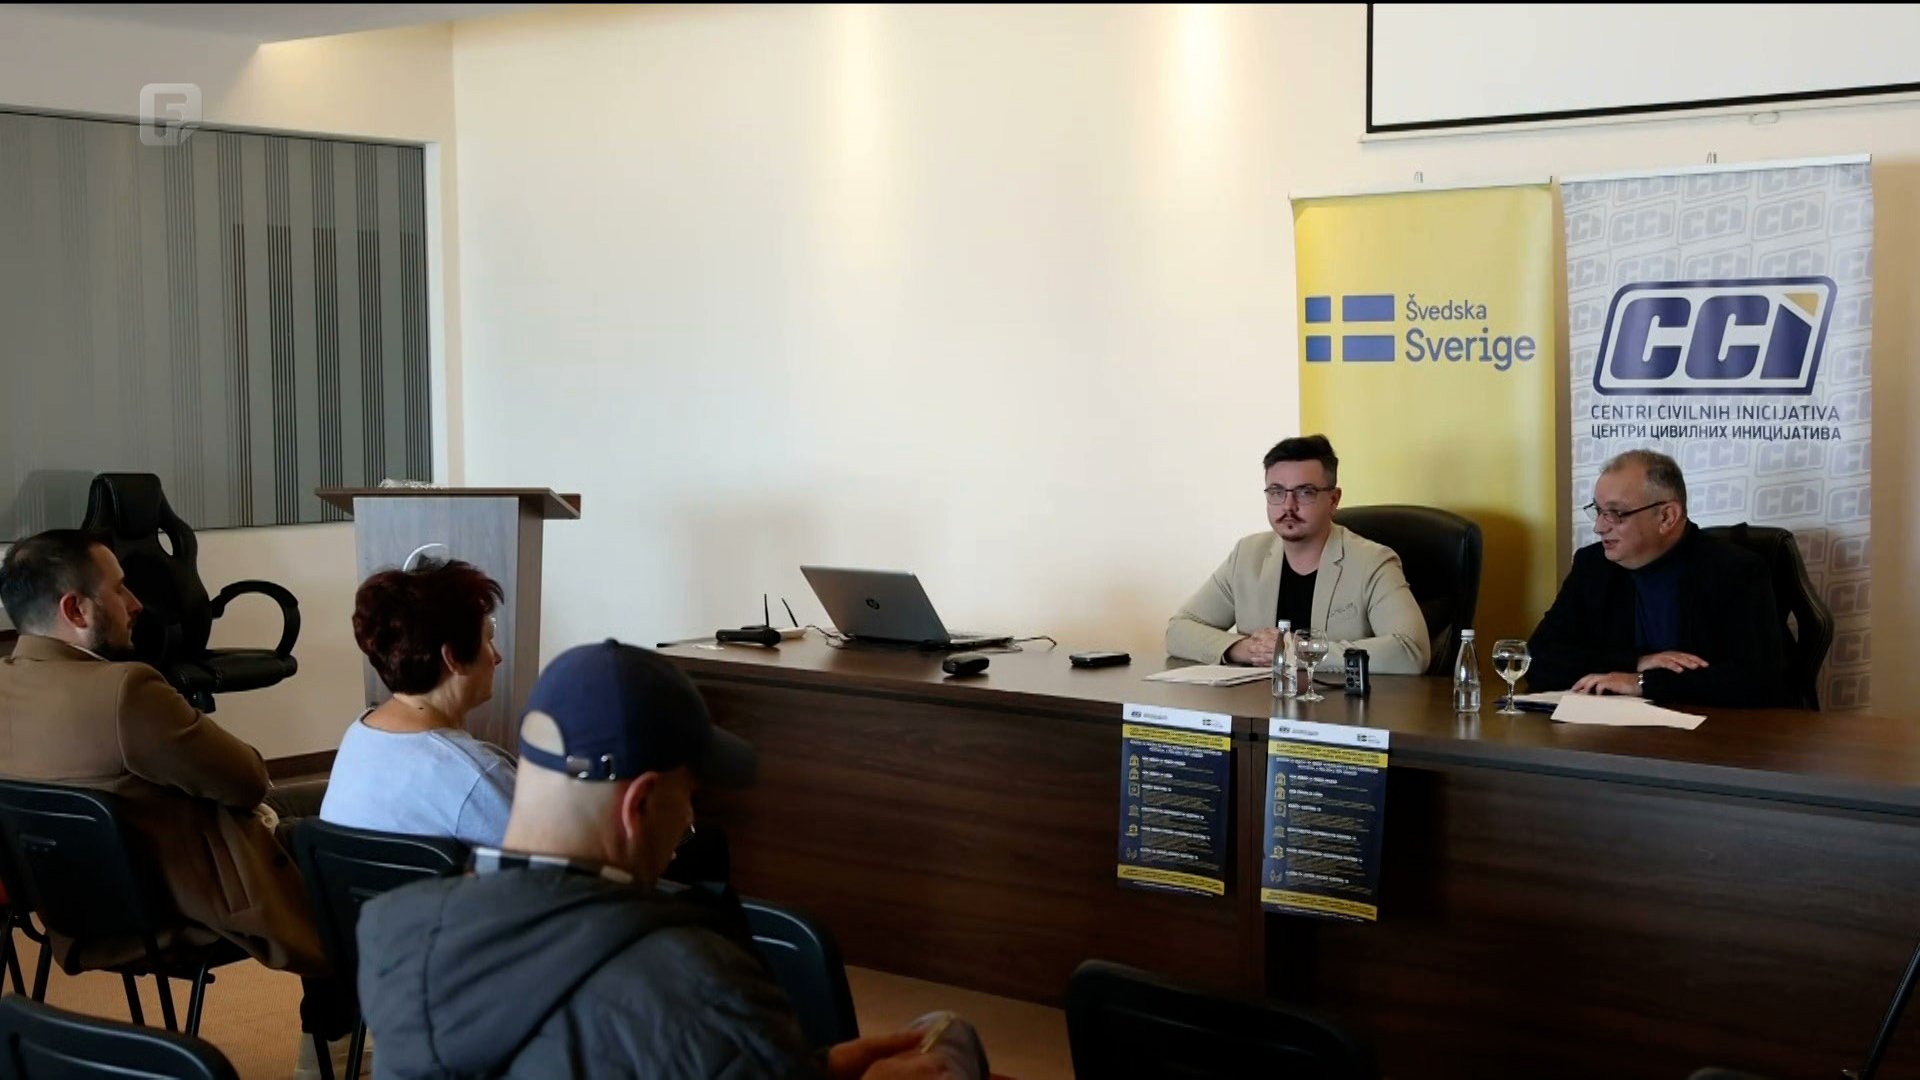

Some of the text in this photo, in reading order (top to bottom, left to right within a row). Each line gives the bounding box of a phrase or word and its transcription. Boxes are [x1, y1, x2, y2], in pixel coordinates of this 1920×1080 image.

[1405, 294, 1487, 322] Švedska
[1405, 327, 1536, 372] Sverige
[1591, 405, 1652, 420] CENTRI
[1657, 405, 1730, 421] CIVILNIH
[1736, 405, 1840, 421] INICIJATIVA
[1591, 424, 1842, 441] ЦЕНТРИ ЦИВИЛНИХ ИНИЦИЈАТИВА
